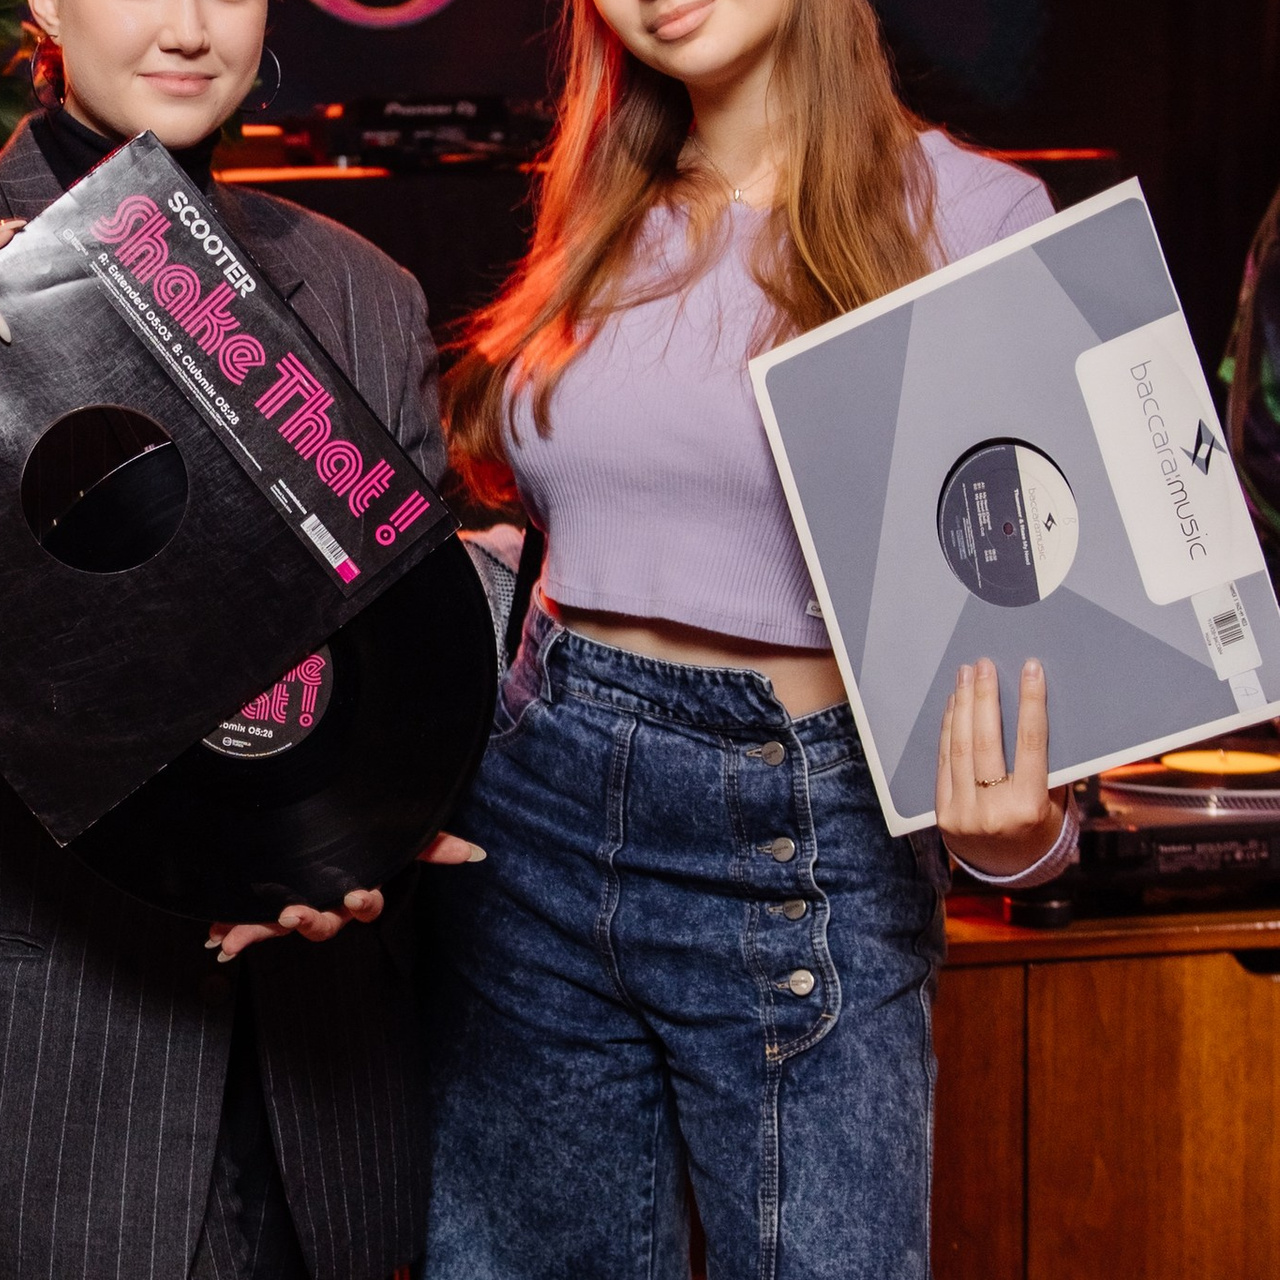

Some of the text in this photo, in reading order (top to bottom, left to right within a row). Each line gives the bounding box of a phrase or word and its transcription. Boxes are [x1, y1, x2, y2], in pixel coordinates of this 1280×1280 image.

[167, 190, 257, 299] SCOOTER
[91, 195, 266, 386] Shake
[254, 351, 396, 518] That
[97, 252, 240, 425] A: Extended 05:03 B: Clubmix 05:28
